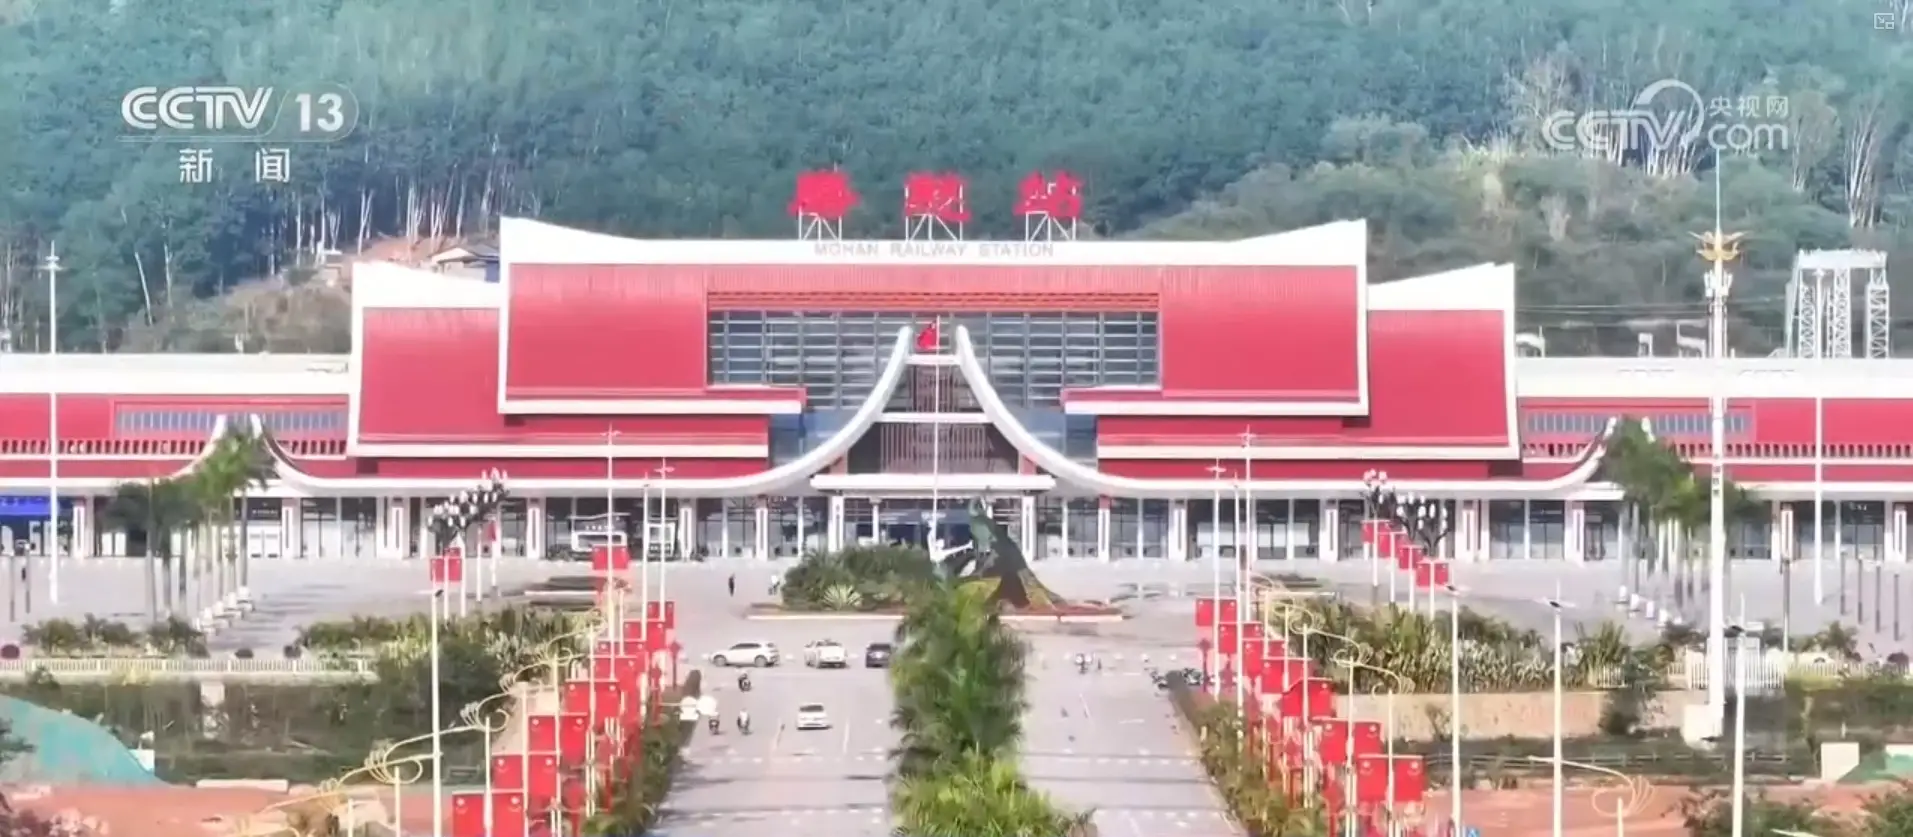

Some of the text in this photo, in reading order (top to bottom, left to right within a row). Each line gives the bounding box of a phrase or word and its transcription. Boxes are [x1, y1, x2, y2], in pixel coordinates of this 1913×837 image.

[814, 242, 1054, 257] MOHAN RAILWAY STATION
